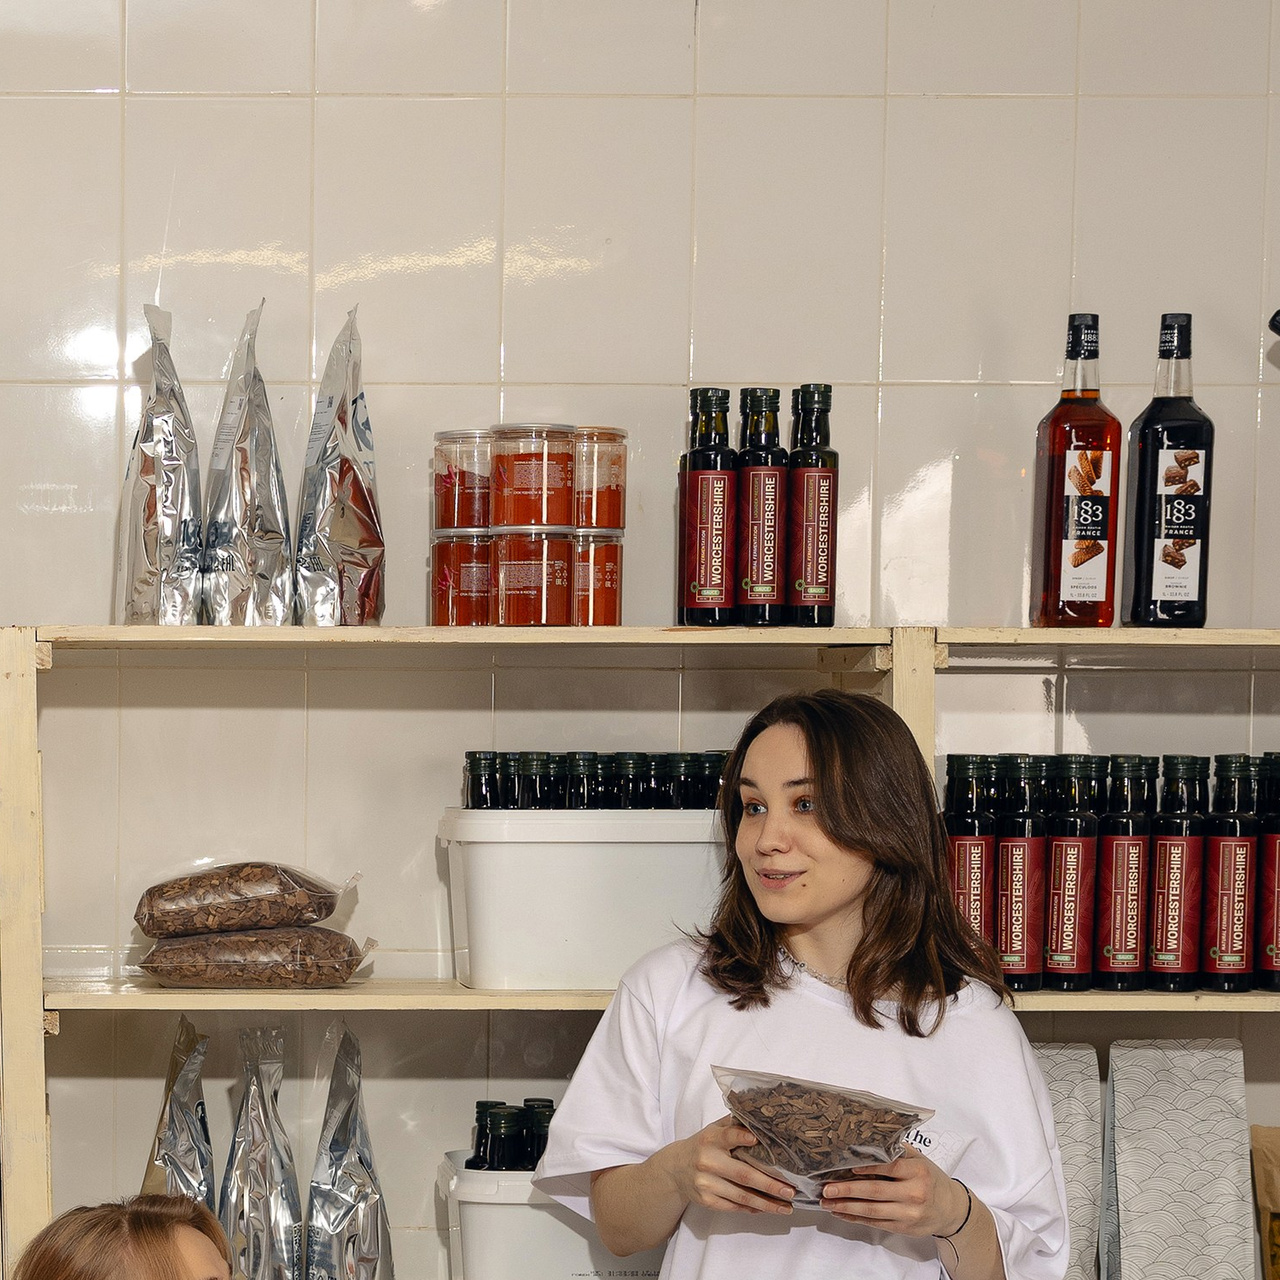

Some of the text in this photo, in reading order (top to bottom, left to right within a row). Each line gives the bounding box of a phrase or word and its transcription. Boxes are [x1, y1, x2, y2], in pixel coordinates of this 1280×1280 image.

[712, 480, 724, 584] WORCESTERSHIRE
[764, 477, 775, 581] WORCESTERSHIRE
[818, 479, 829, 582] WORCESTERSHIRE
[1165, 499, 1196, 524] 1883
[1012, 847, 1023, 951] WORCESTERSHIRE
[1062, 846, 1077, 951] WORCESTERSHIRE
[1126, 845, 1139, 949] WORCESTERSHIRE
[1167, 846, 1181, 950] WORCESTERSHIRE
[1233, 846, 1246, 951] WORCESTERSHIRE
